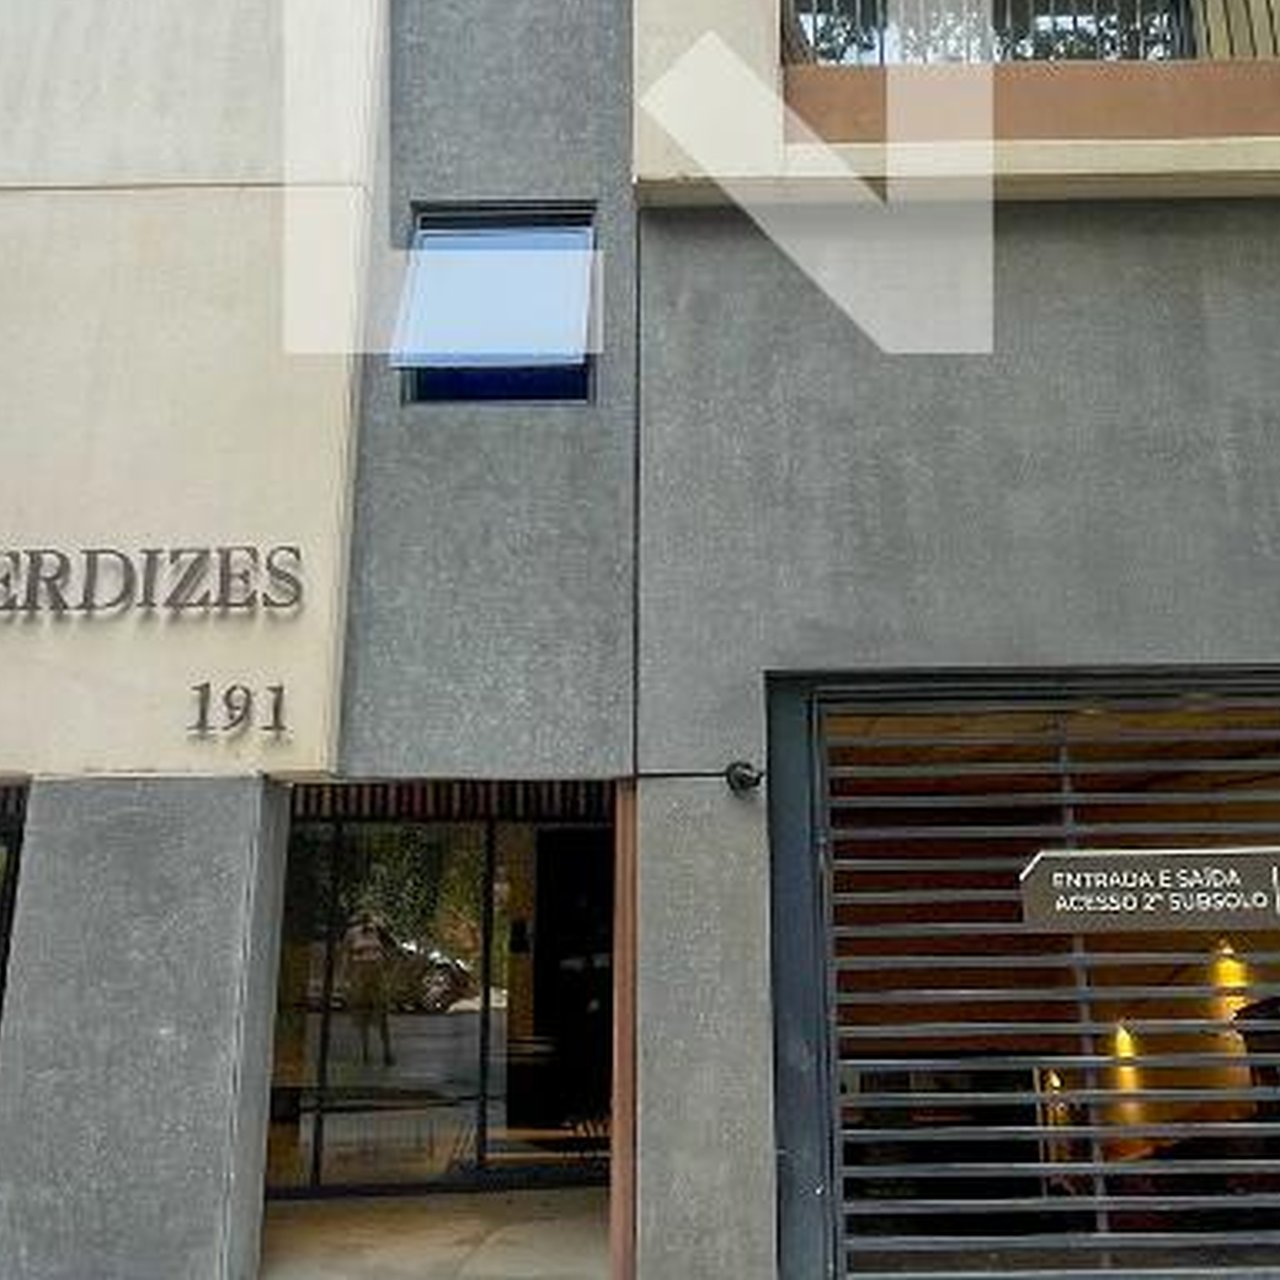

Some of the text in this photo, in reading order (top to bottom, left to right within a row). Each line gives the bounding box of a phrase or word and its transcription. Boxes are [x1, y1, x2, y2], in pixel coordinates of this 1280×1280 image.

[187, 681, 287, 733] 191
[1159, 869, 1171, 887] E
[1055, 893, 1139, 912] ACESSO
[1170, 891, 1269, 912] SUBSOLO
